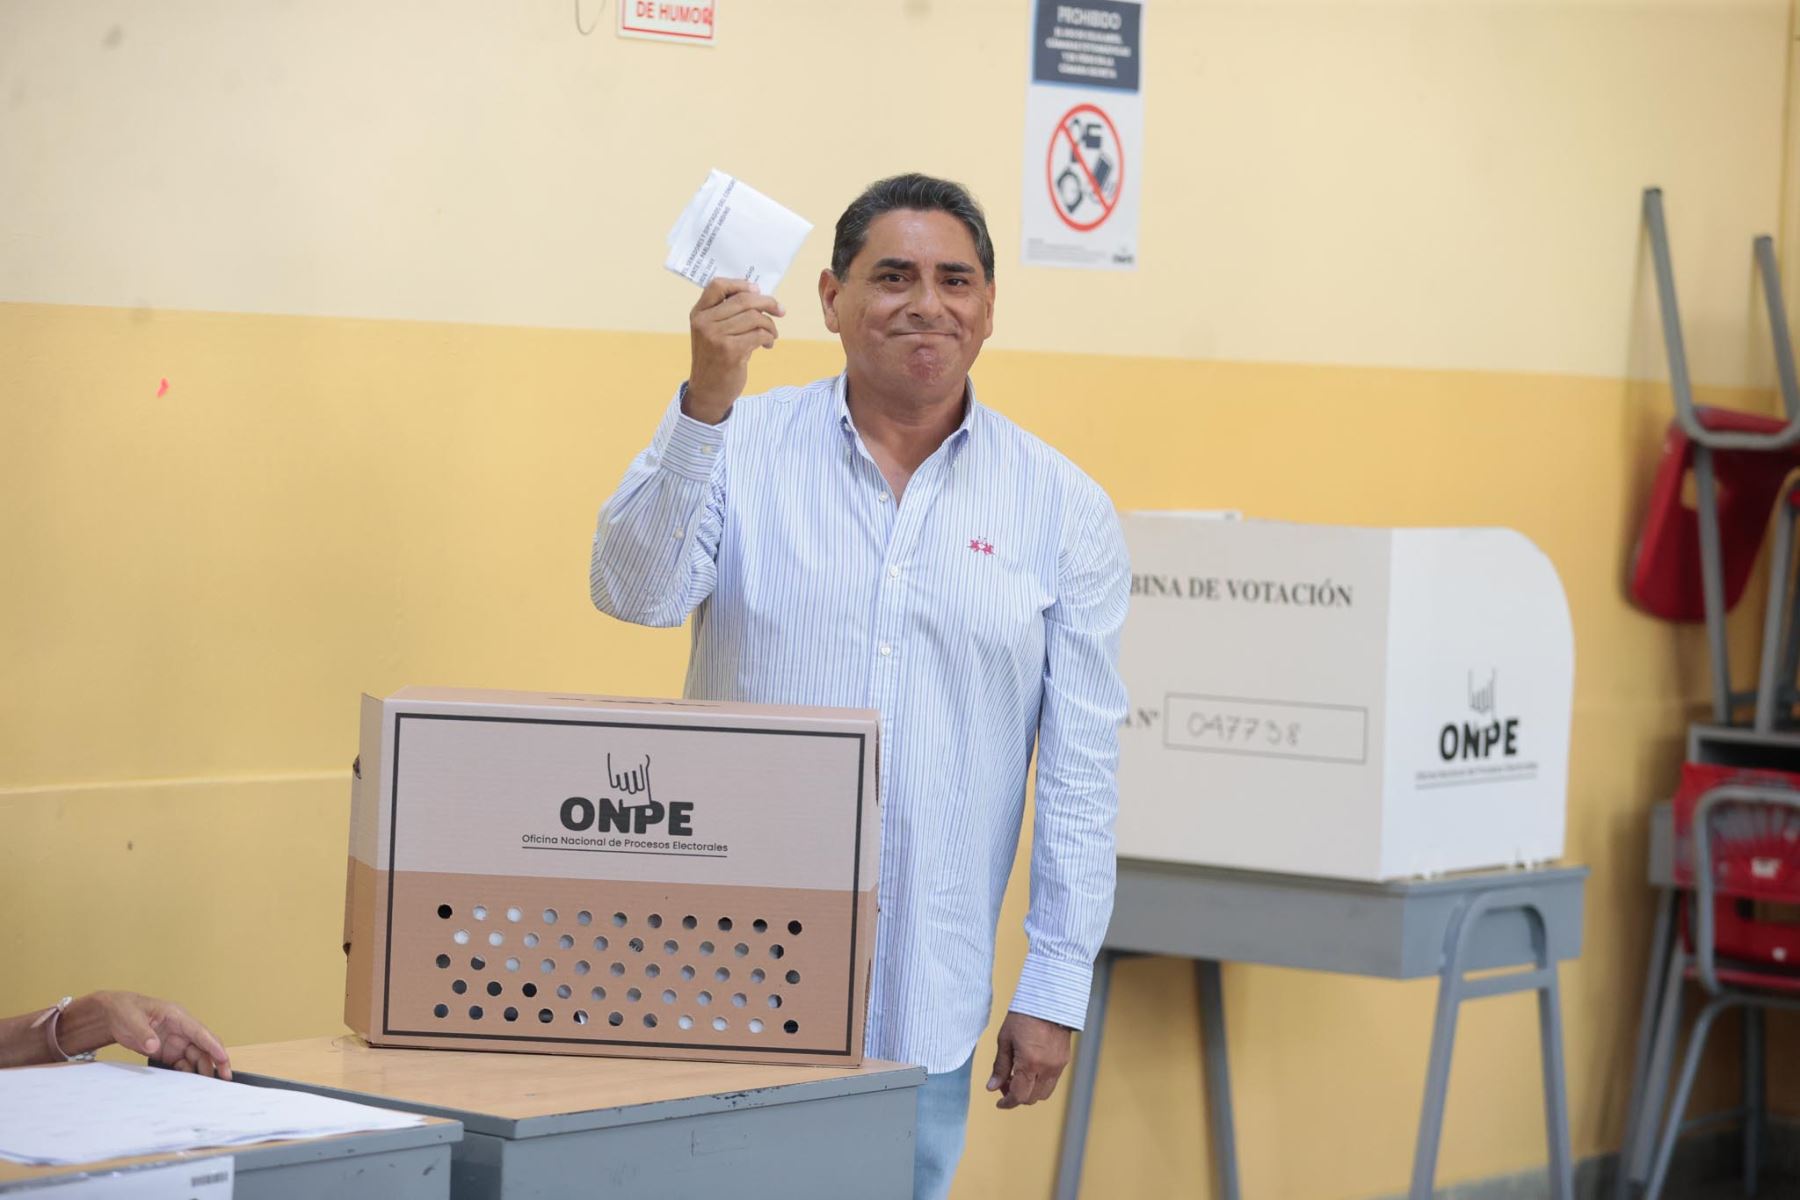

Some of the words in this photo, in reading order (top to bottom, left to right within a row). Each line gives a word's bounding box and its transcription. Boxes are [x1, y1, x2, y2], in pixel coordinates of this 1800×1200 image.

[636, 1, 654, 18] DE
[659, 4, 712, 25] HUMOR
[1189, 576, 1221, 600] DE
[1227, 579, 1353, 607] VOTACIÓN
[1440, 718, 1518, 761] ONPE
[560, 796, 694, 836] ONPE
[522, 834, 558, 845] Oficina
[561, 837, 606, 847] Nacional
[608, 838, 622, 847] de
[624, 839, 670, 850] Procesos
[672, 841, 728, 852] Electorales
